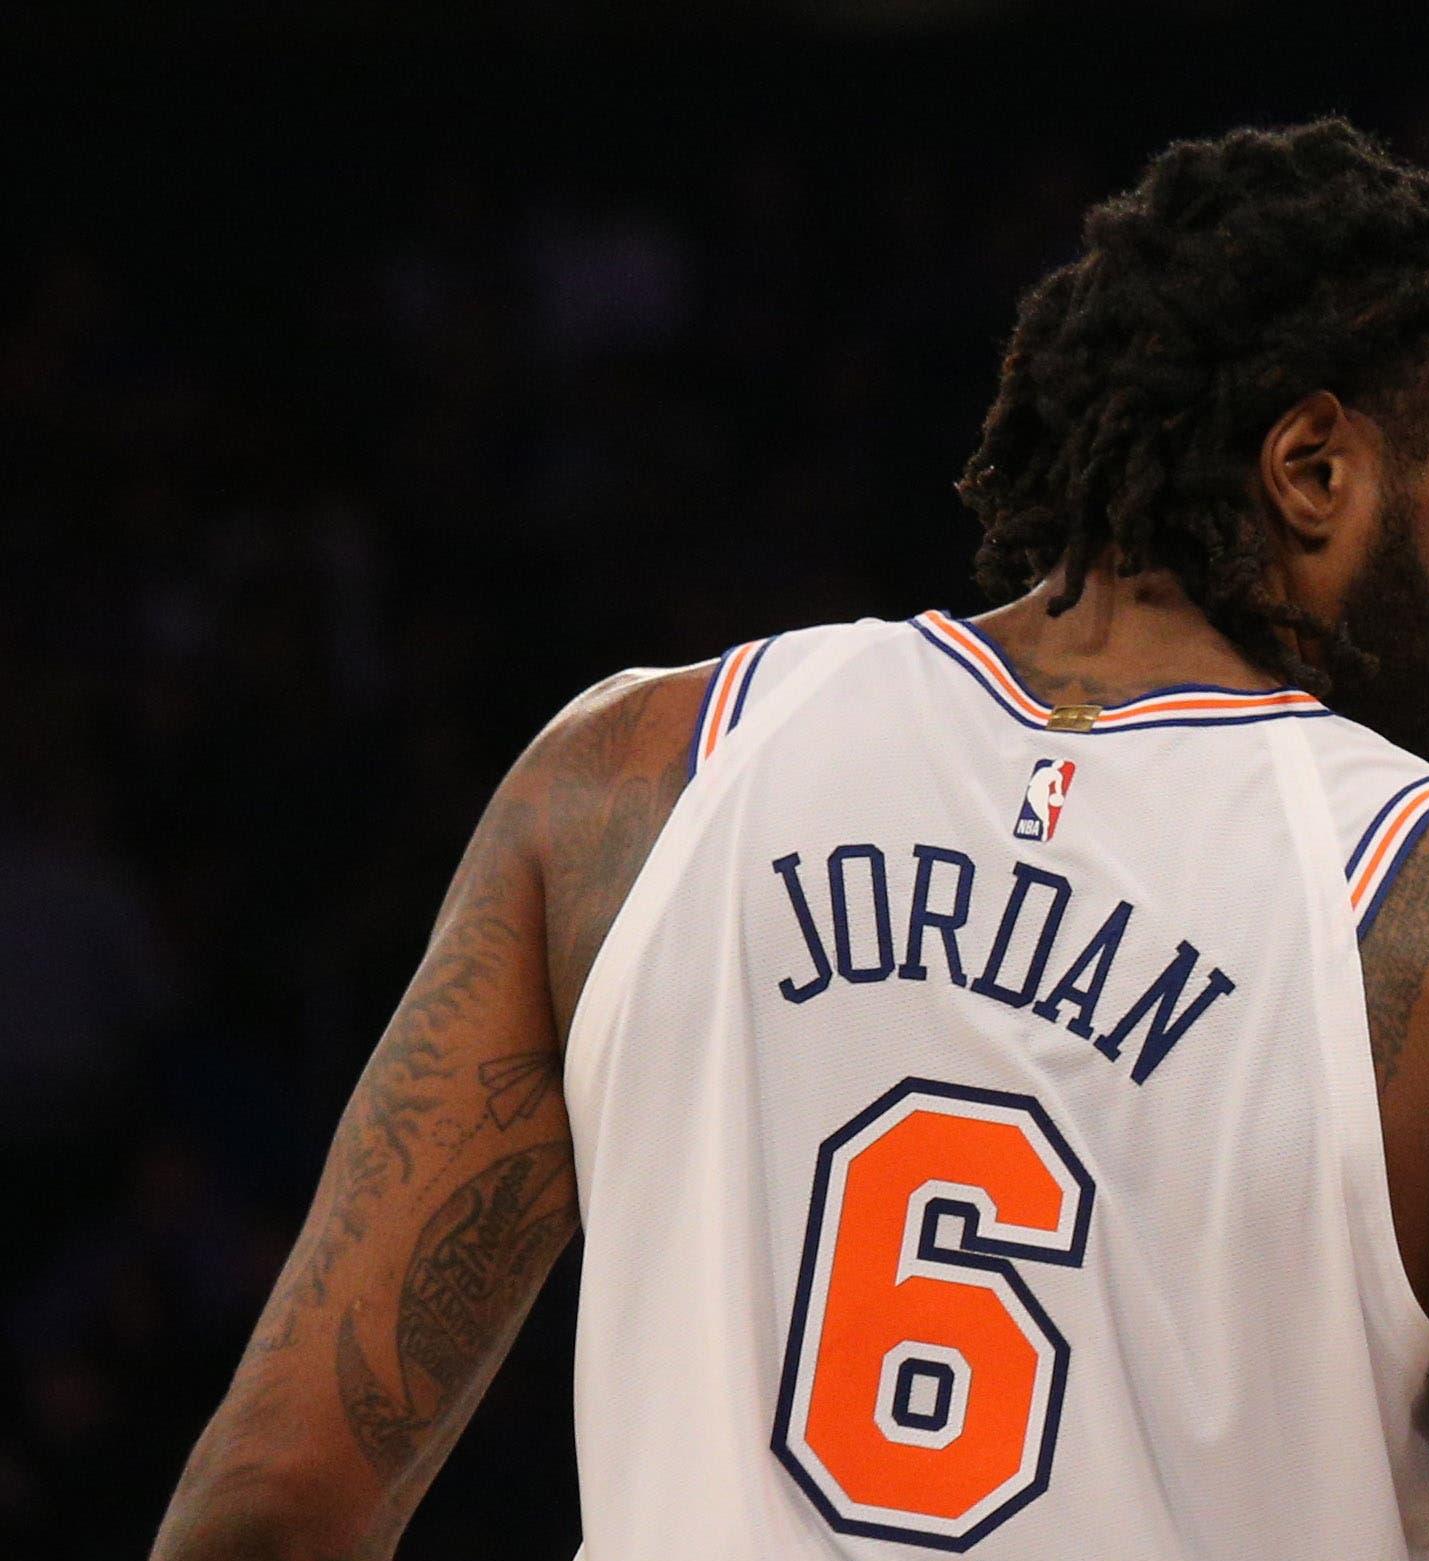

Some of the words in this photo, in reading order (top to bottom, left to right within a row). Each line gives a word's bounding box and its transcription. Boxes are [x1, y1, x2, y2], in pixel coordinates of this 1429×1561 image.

[1017, 819, 1040, 836] NBA
[772, 843, 1237, 1087] JORDAN
[770, 1075, 1097, 1554] 6
